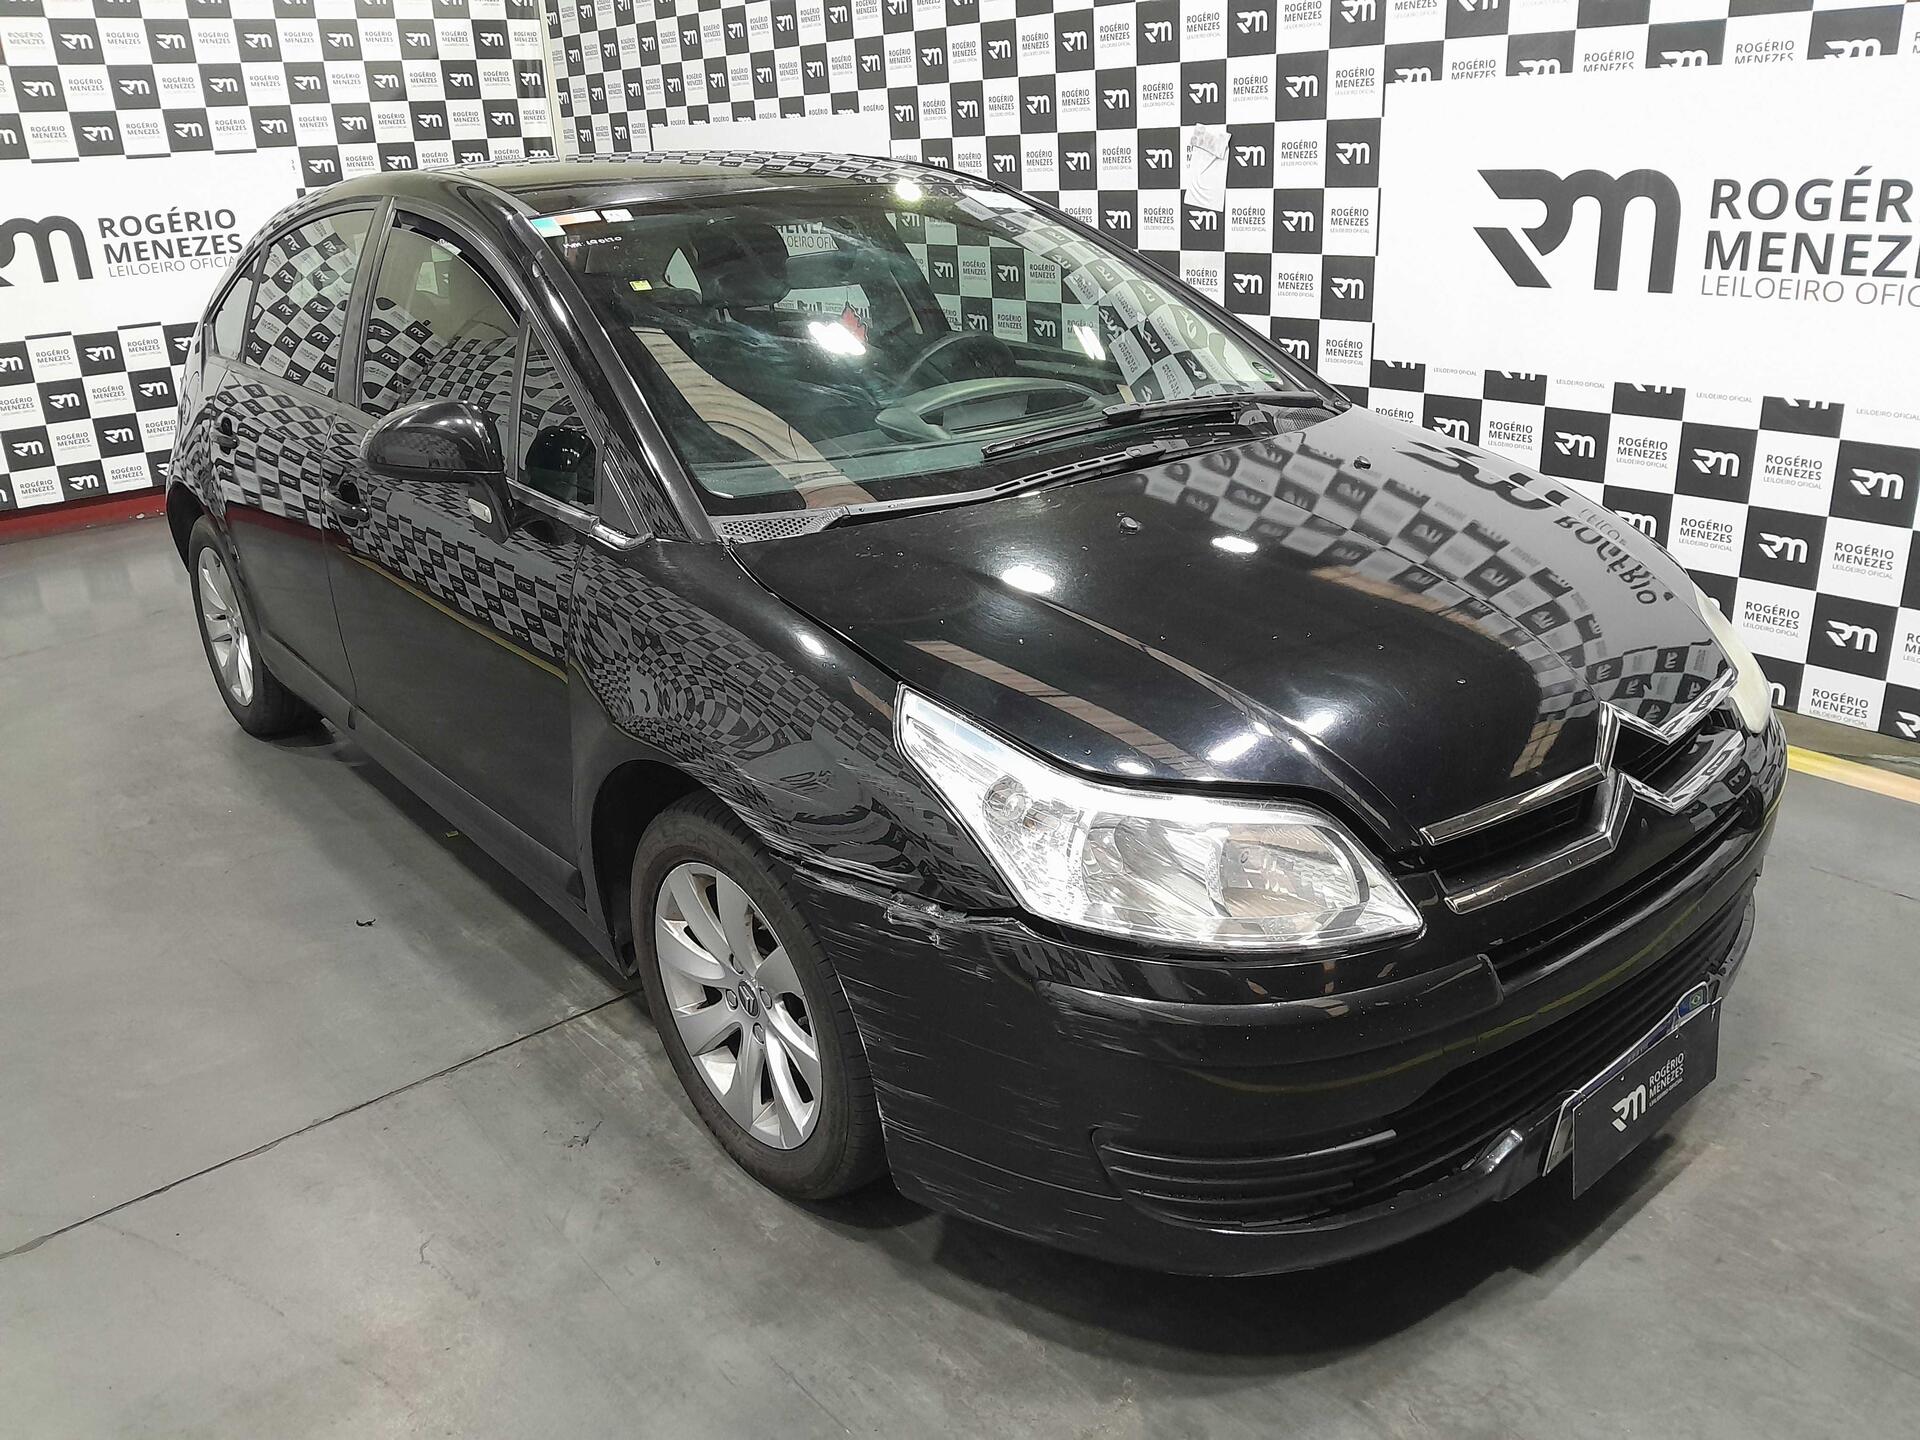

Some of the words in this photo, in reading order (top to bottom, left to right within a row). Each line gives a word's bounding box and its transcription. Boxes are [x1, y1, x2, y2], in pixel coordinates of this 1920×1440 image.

[1284, 1, 1322, 12] ROGÉRIO
[1187, 12, 1220, 23] ROGÉRIO
[1284, 11, 1322, 22] MENEZES
[1187, 22, 1220, 32] MENEZES
[1022, 33, 1048, 42] ROGÉRIO
[952, 41, 976, 49] ROGÉRIO
[1022, 41, 1049, 50] MENEZES
[1736, 40, 1794, 53] ROGÉRIO
[952, 49, 976, 58] MENEZES
[1584, 50, 1634, 62] ROGÉRIO
[1452, 59, 1496, 70] ROGÉRIO
[1336, 68, 1374, 78] ROGÉRIO
[1233, 76, 1268, 86] ROGÉRIO
[1336, 77, 1374, 88] MENEZES
[1062, 89, 1089, 98] ROGÉRIO
[1233, 85, 1268, 94] MENEZES
[1062, 97, 1090, 106] MENEZES
[1281, 140, 1317, 150] ROGÉRIO
[1026, 150, 1052, 159] ROGÉRIO
[1281, 150, 1318, 159] MENEZES
[1027, 157, 1053, 166] MENEZES
[1232, 207, 1265, 216] ROGÉRIO
[1331, 208, 1369, 217] ROGÉRIO
[98, 207, 235, 238] ROGÉRIO
[1232, 215, 1266, 224] MENEZES
[1331, 217, 1369, 226] MENEZES
[104, 234, 242, 264] MENEZES
[1705, 231, 1920, 278] MENEZ
[109, 261, 185, 277] LEILOEIRO
[1186, 268, 1217, 277] ROGÉRIO
[1186, 277, 1217, 286] MENEZES
[1278, 272, 1313, 281] ROGÉRIO
[1278, 281, 1313, 290] MENEZES
[1702, 275, 1844, 302] LEILOEIRO
[127, 339, 158, 347] ROGÉRIO
[1326, 339, 1363, 349] ROGÉRIO
[36, 349, 68, 357] ROGÉRIO
[1326, 348, 1363, 359] MENEZES
[37, 355, 71, 363] MENEZES
[92, 385, 123, 393] ROGÉRIO
[93, 391, 125, 399] MENEZES
[1696, 392, 1727, 400] LEILOEIRO
[1729, 395, 1752, 403] OFICIAL
[1857, 408, 1892, 418] LEILOEIRO
[1894, 411, 1920, 421] OFICIAL
[1489, 421, 1532, 433] ROGÉRIO
[56, 432, 88, 440] ROGÉRIO
[1489, 431, 1532, 443] MENEZES
[57, 438, 90, 446] MENEZES
[1618, 437, 1668, 450] ROGÉRIO
[1617, 447, 1667, 460] MENEZES
[1766, 455, 1822, 469] ROGÉRIO
[111, 466, 141, 474] ROGÉRIO
[1765, 465, 1822, 480] MENEZES
[112, 472, 143, 480] MENEZES
[1681, 518, 1733, 533] ROGÉRIO
[1680, 528, 1732, 543] MENEZES
[1835, 542, 1894, 559] ROGÉRIO
[1834, 553, 1893, 570] MENEZES
[1746, 601, 1800, 619] ROGÉRIO
[1744, 612, 1799, 629] MENEZES
[1812, 688, 1868, 708] ROGÉRIO
[1811, 699, 1868, 718] MENEZES
[1650, 1053, 1684, 1086] ROGÉRIO
[1650, 1064, 1683, 1098] MENEZES
